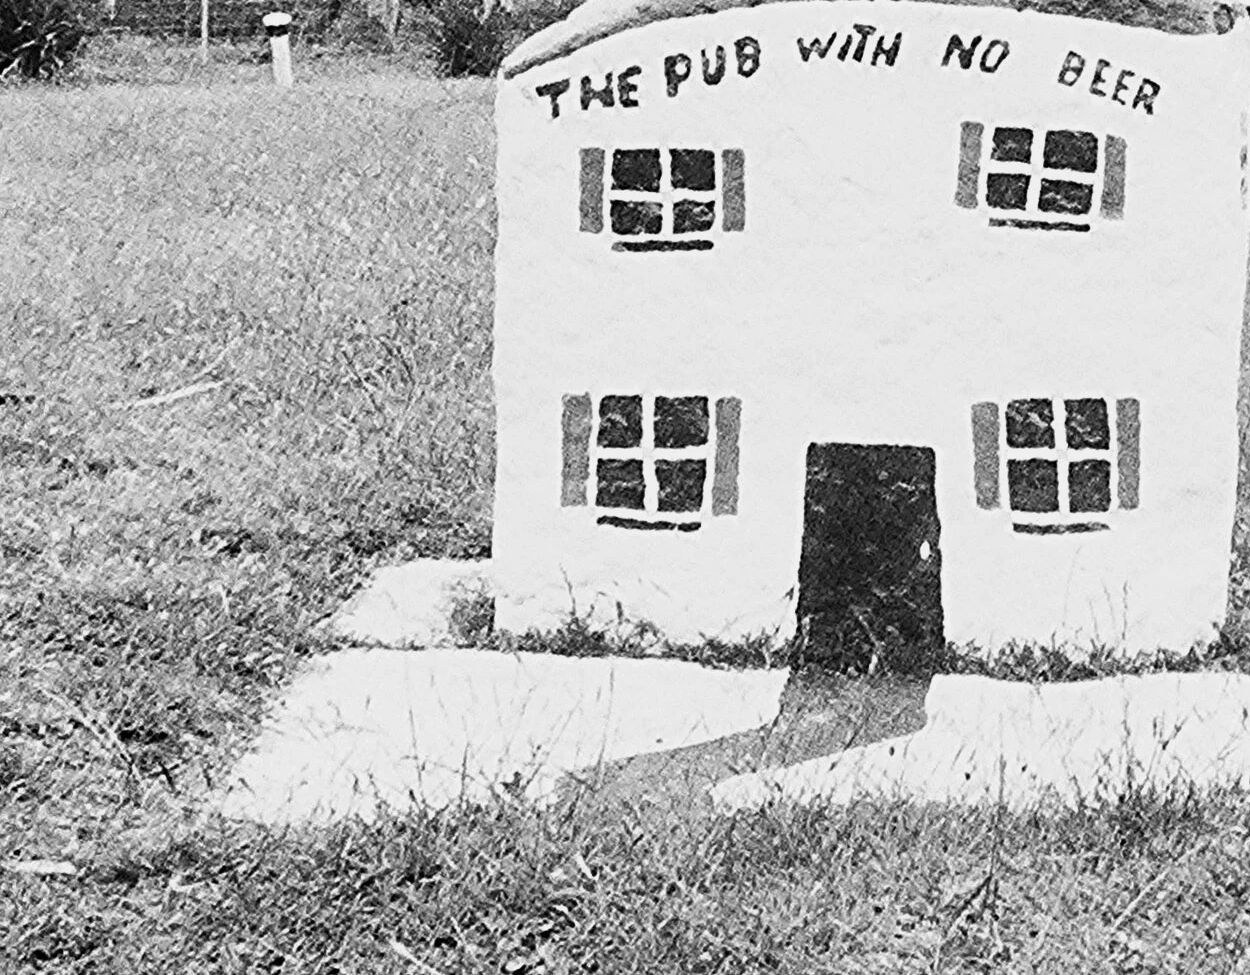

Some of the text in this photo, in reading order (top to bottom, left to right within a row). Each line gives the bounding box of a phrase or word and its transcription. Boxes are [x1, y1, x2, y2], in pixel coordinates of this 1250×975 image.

[535, 23, 1161, 120] THE PUB WITH NO BEER
